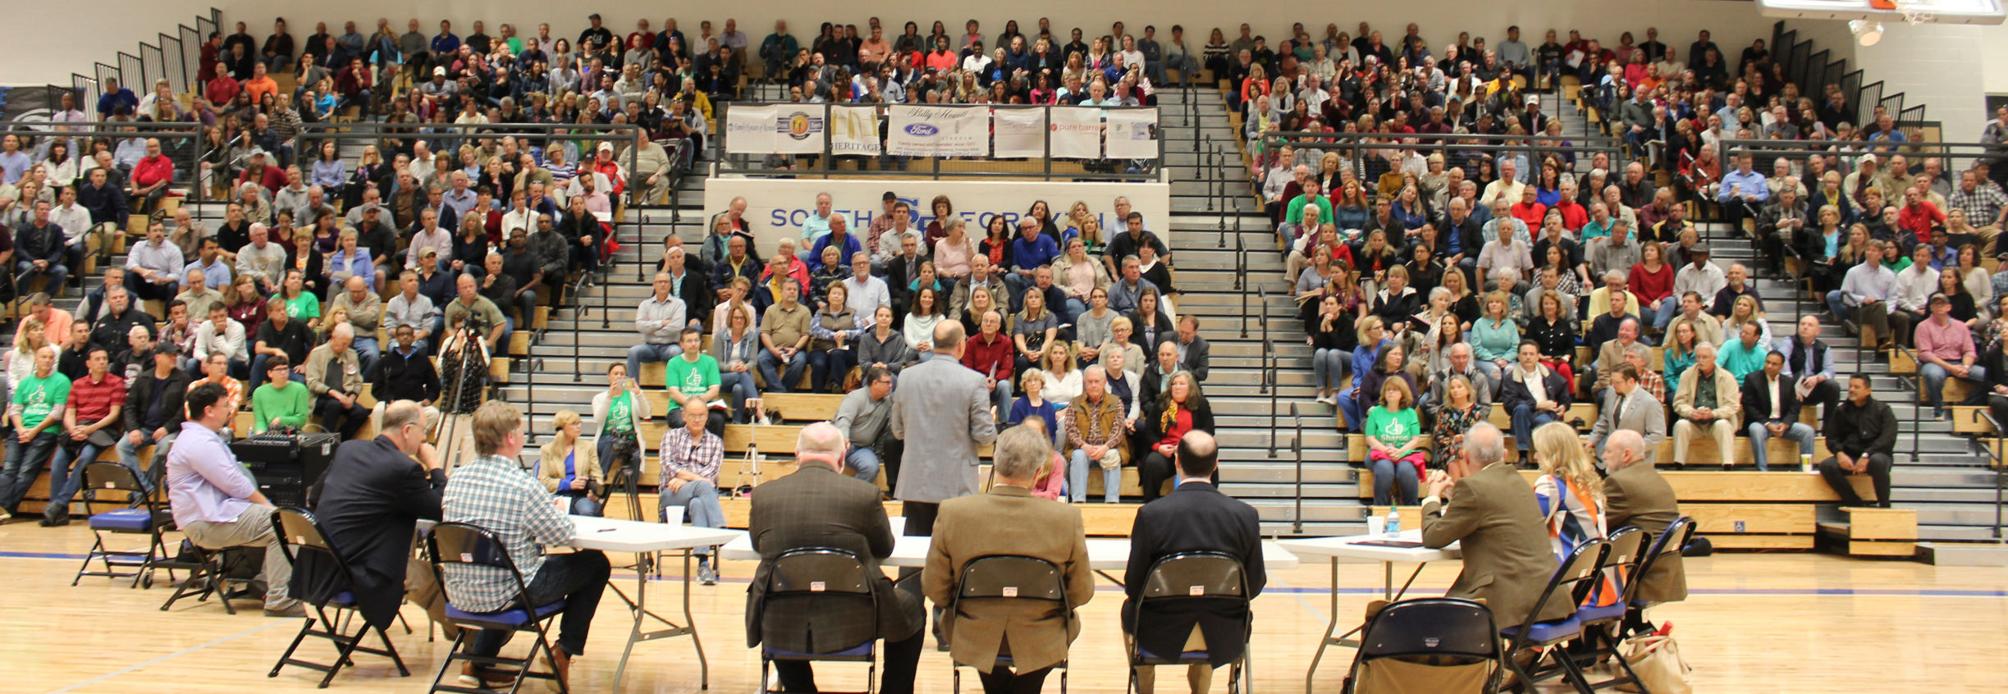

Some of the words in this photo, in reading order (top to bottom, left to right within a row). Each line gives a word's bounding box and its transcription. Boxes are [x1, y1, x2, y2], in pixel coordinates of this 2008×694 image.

[908, 123, 933, 135] Ford
[831, 142, 880, 151] HERITAGE
[771, 208, 873, 227] SOH
